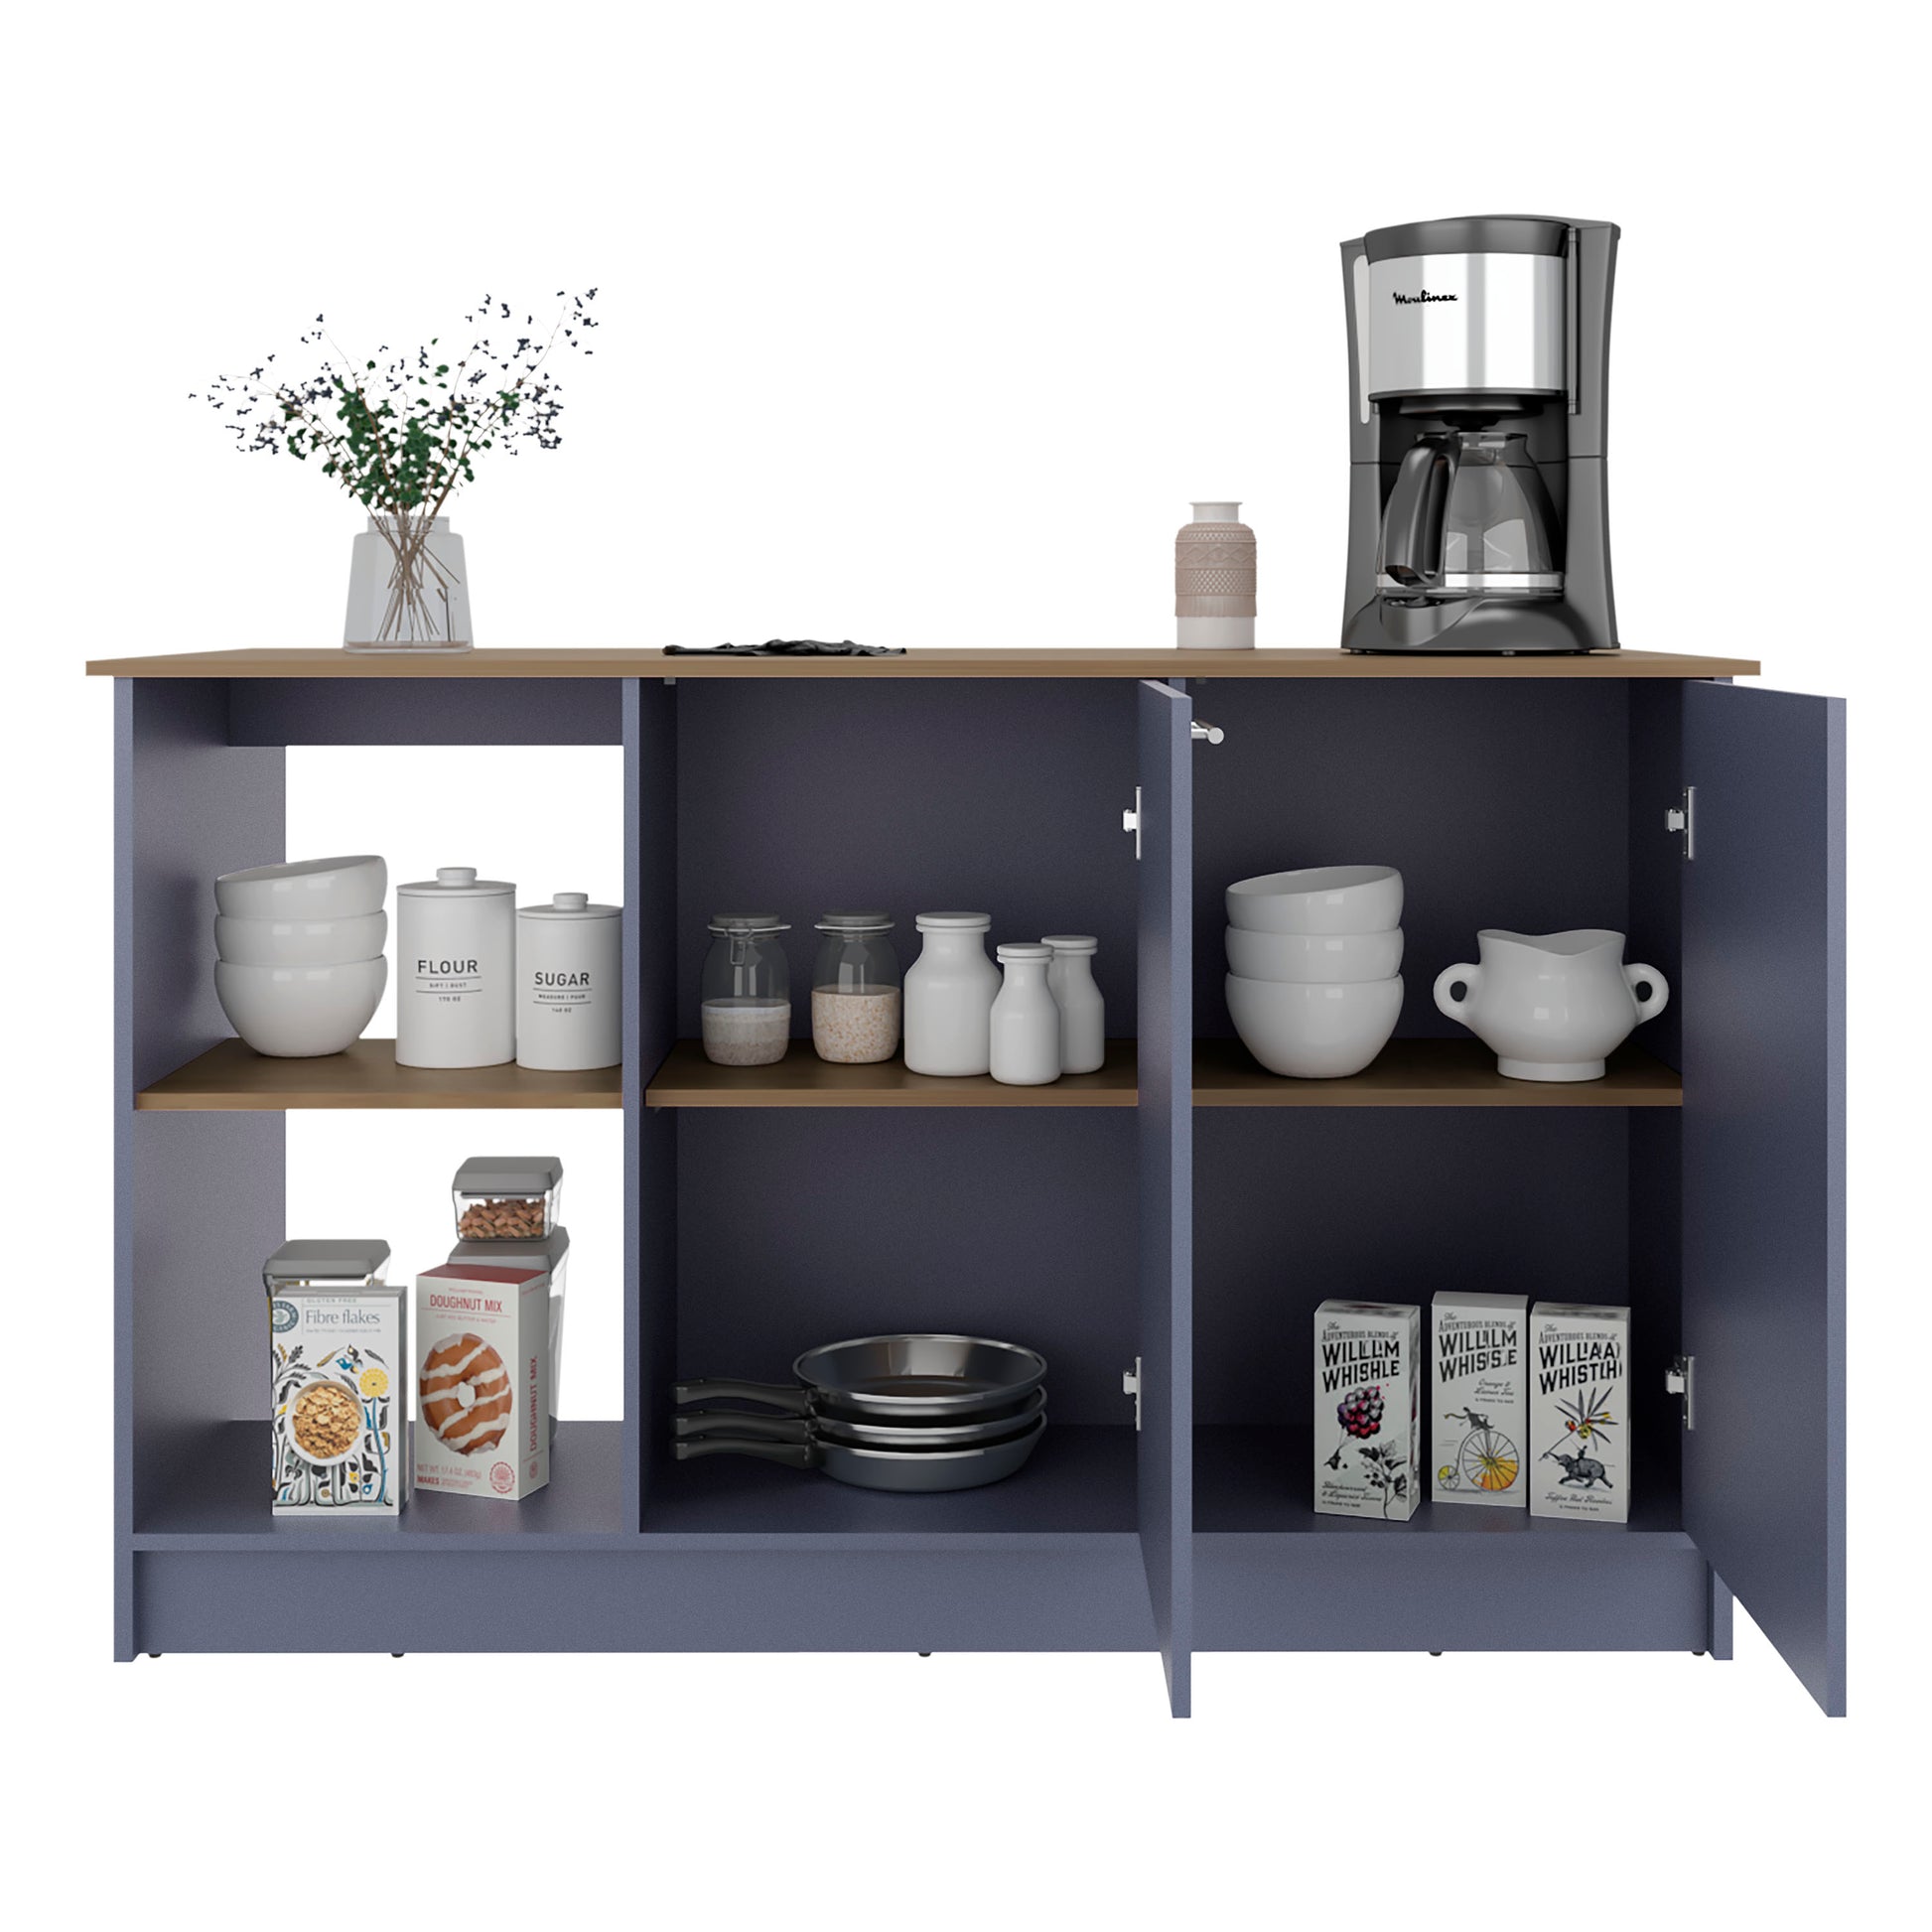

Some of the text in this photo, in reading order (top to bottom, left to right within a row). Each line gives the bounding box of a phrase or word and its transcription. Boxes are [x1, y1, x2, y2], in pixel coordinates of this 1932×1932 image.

[1393, 289, 1457, 304] Moulinex
[418, 960, 478, 974] FLOUR
[535, 972, 590, 986] SUGAR
[429, 1294, 502, 1312] DOUGHNUT MIX
[306, 1309, 380, 1324] Fibre flakes
[529, 1356, 538, 1451] DOUGHNUT MIX
